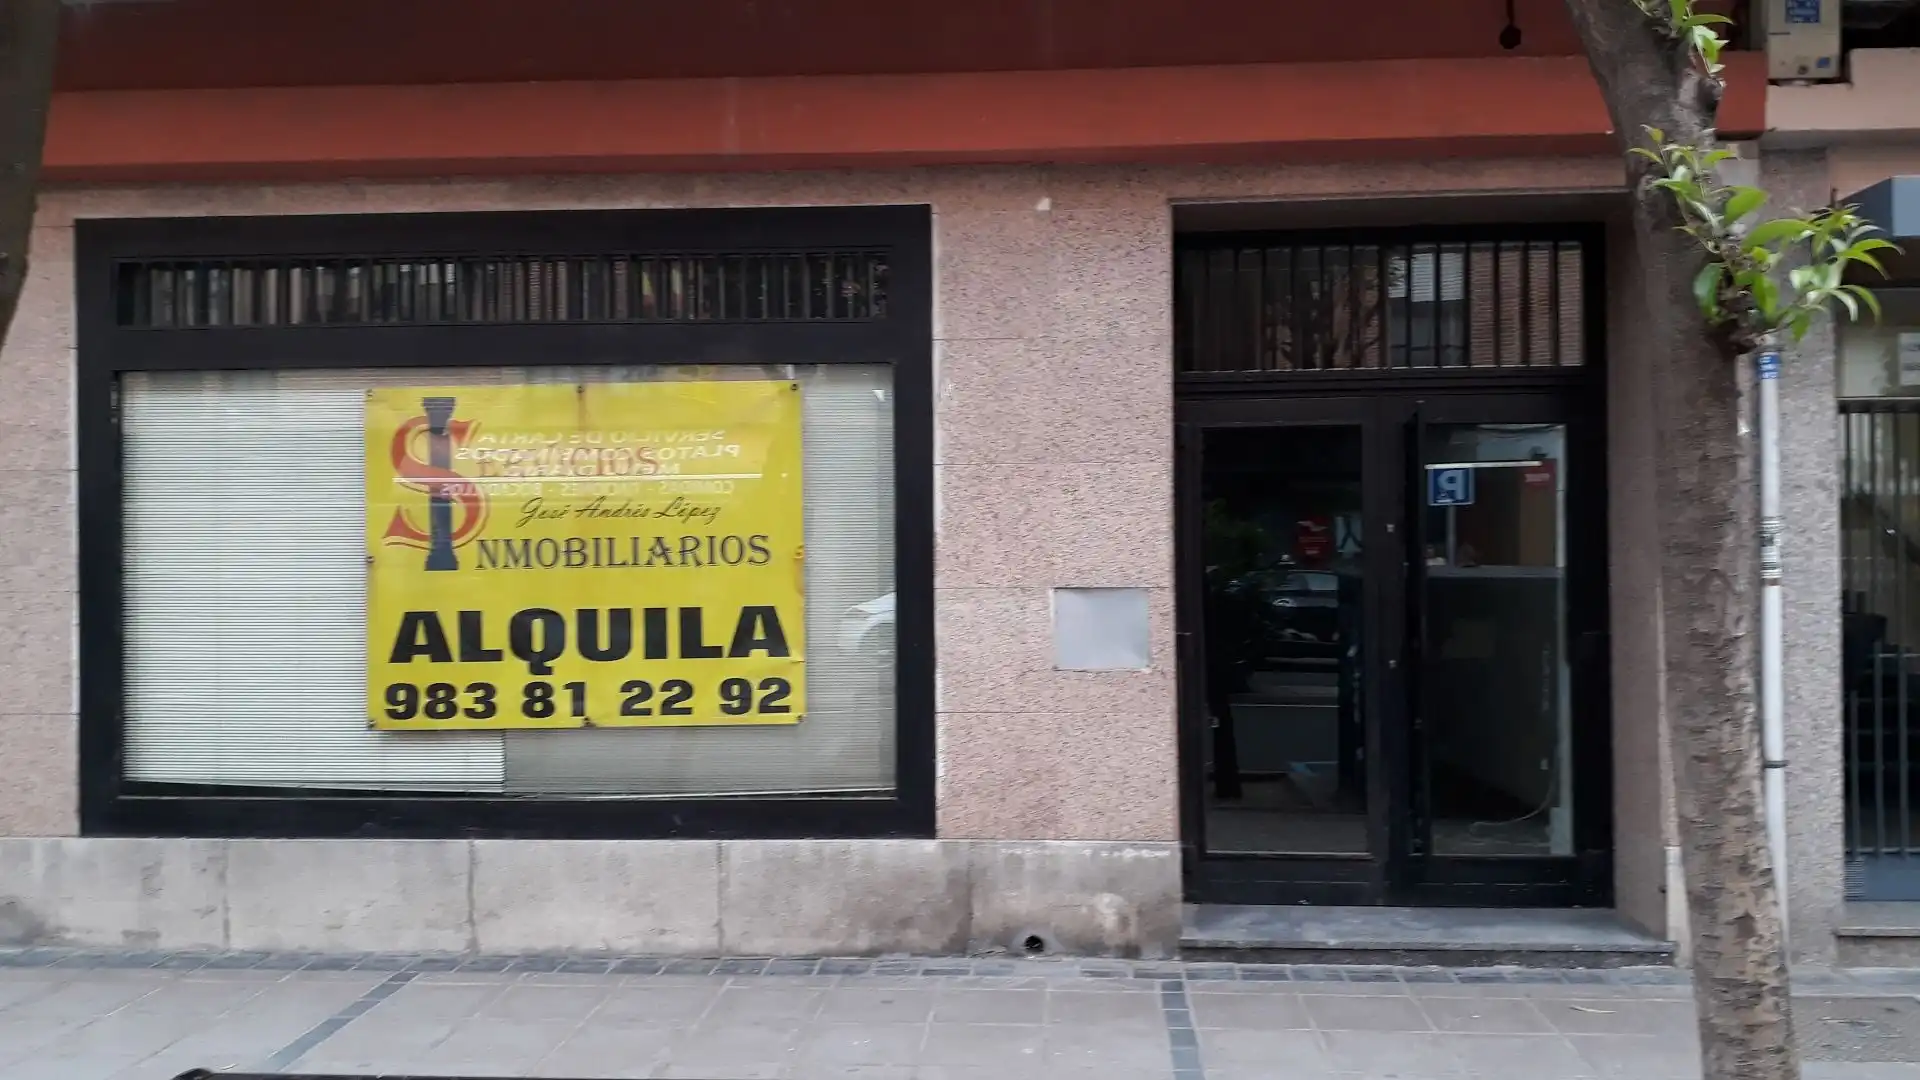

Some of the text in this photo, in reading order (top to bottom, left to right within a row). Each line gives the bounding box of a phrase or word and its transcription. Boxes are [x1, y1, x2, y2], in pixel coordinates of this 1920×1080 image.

[653, 496, 722, 526] López
[388, 605, 791, 676] ALQUILA
[384, 677, 792, 721] 983 81 22 92
